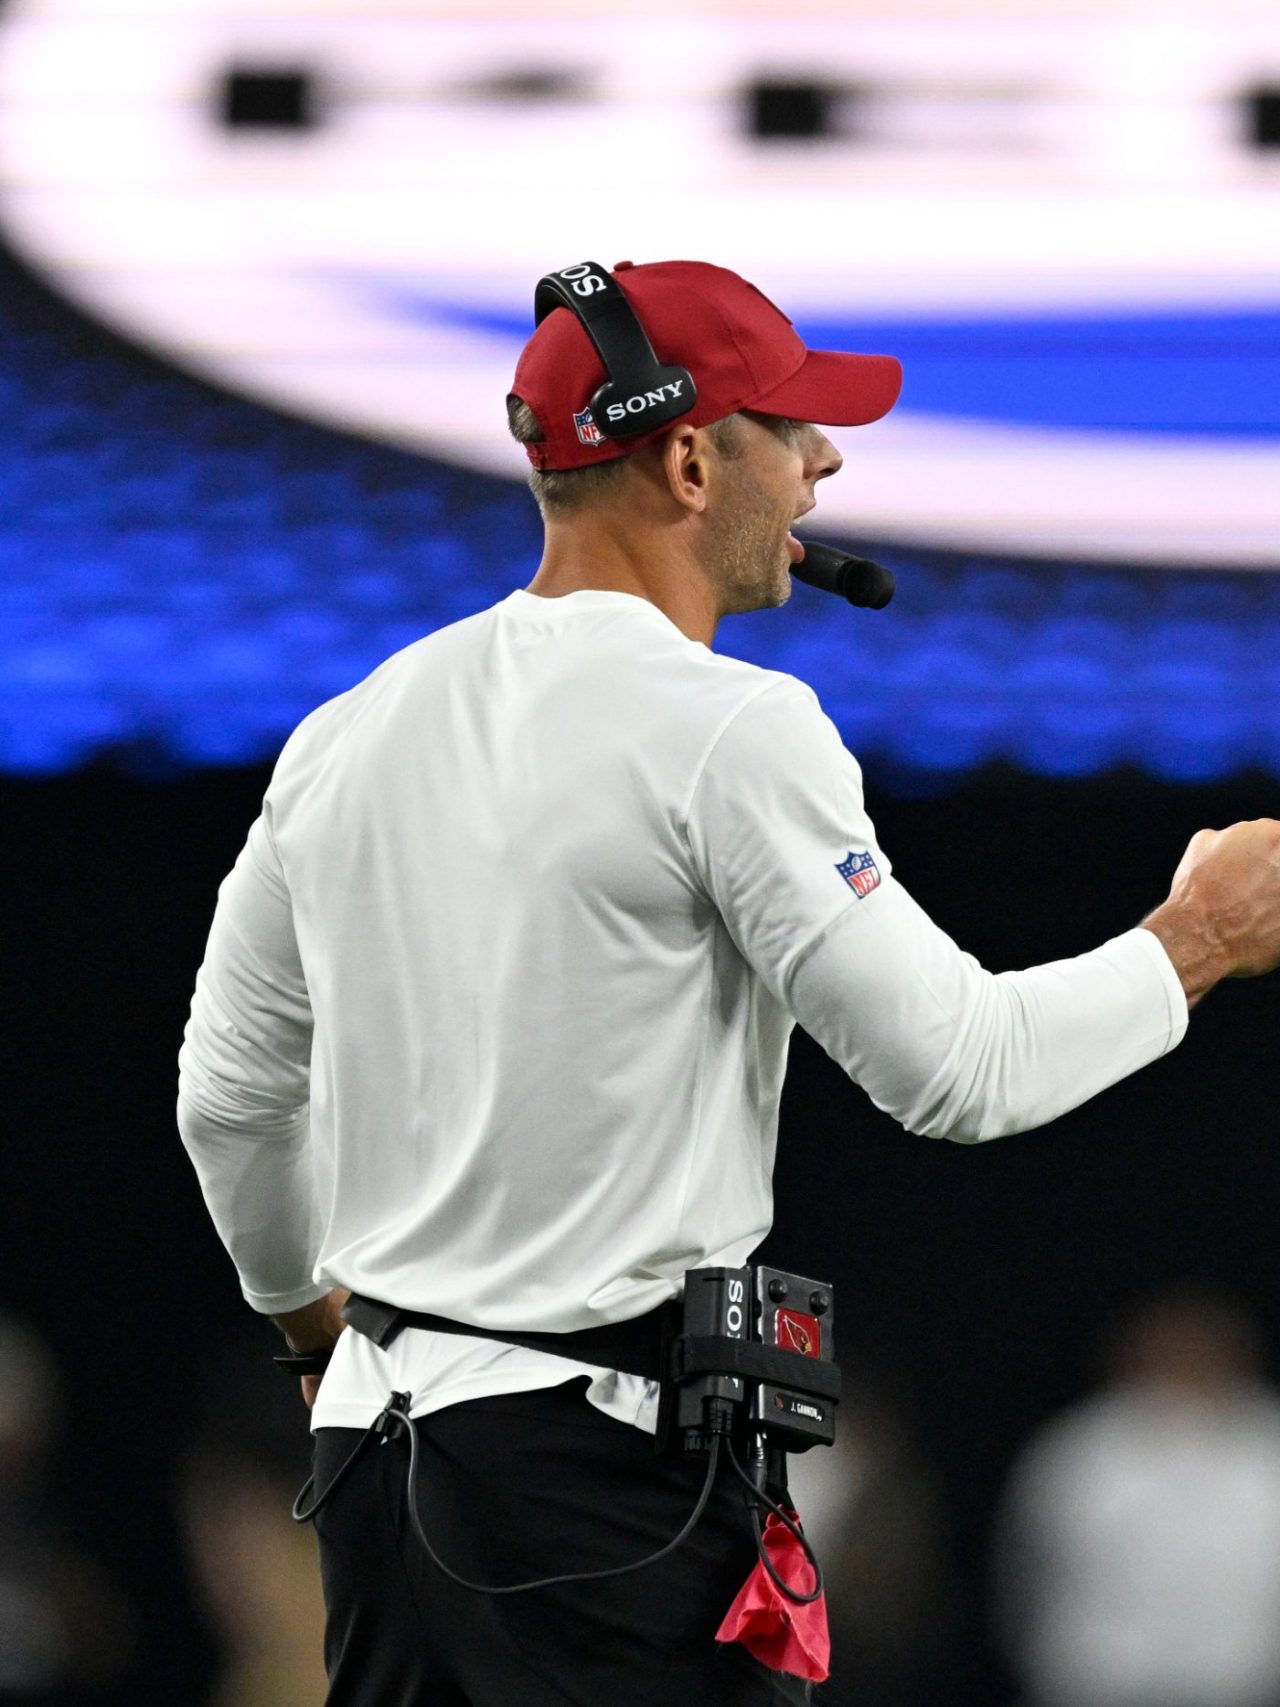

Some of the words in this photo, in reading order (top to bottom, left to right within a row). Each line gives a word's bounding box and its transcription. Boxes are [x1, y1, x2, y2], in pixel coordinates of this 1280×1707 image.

[559, 264, 608, 297] SO
[606, 379, 684, 422] SONY
[580, 423, 601, 441] NF
[848, 868, 881, 898] NFL
[727, 1279, 744, 1339] SO
